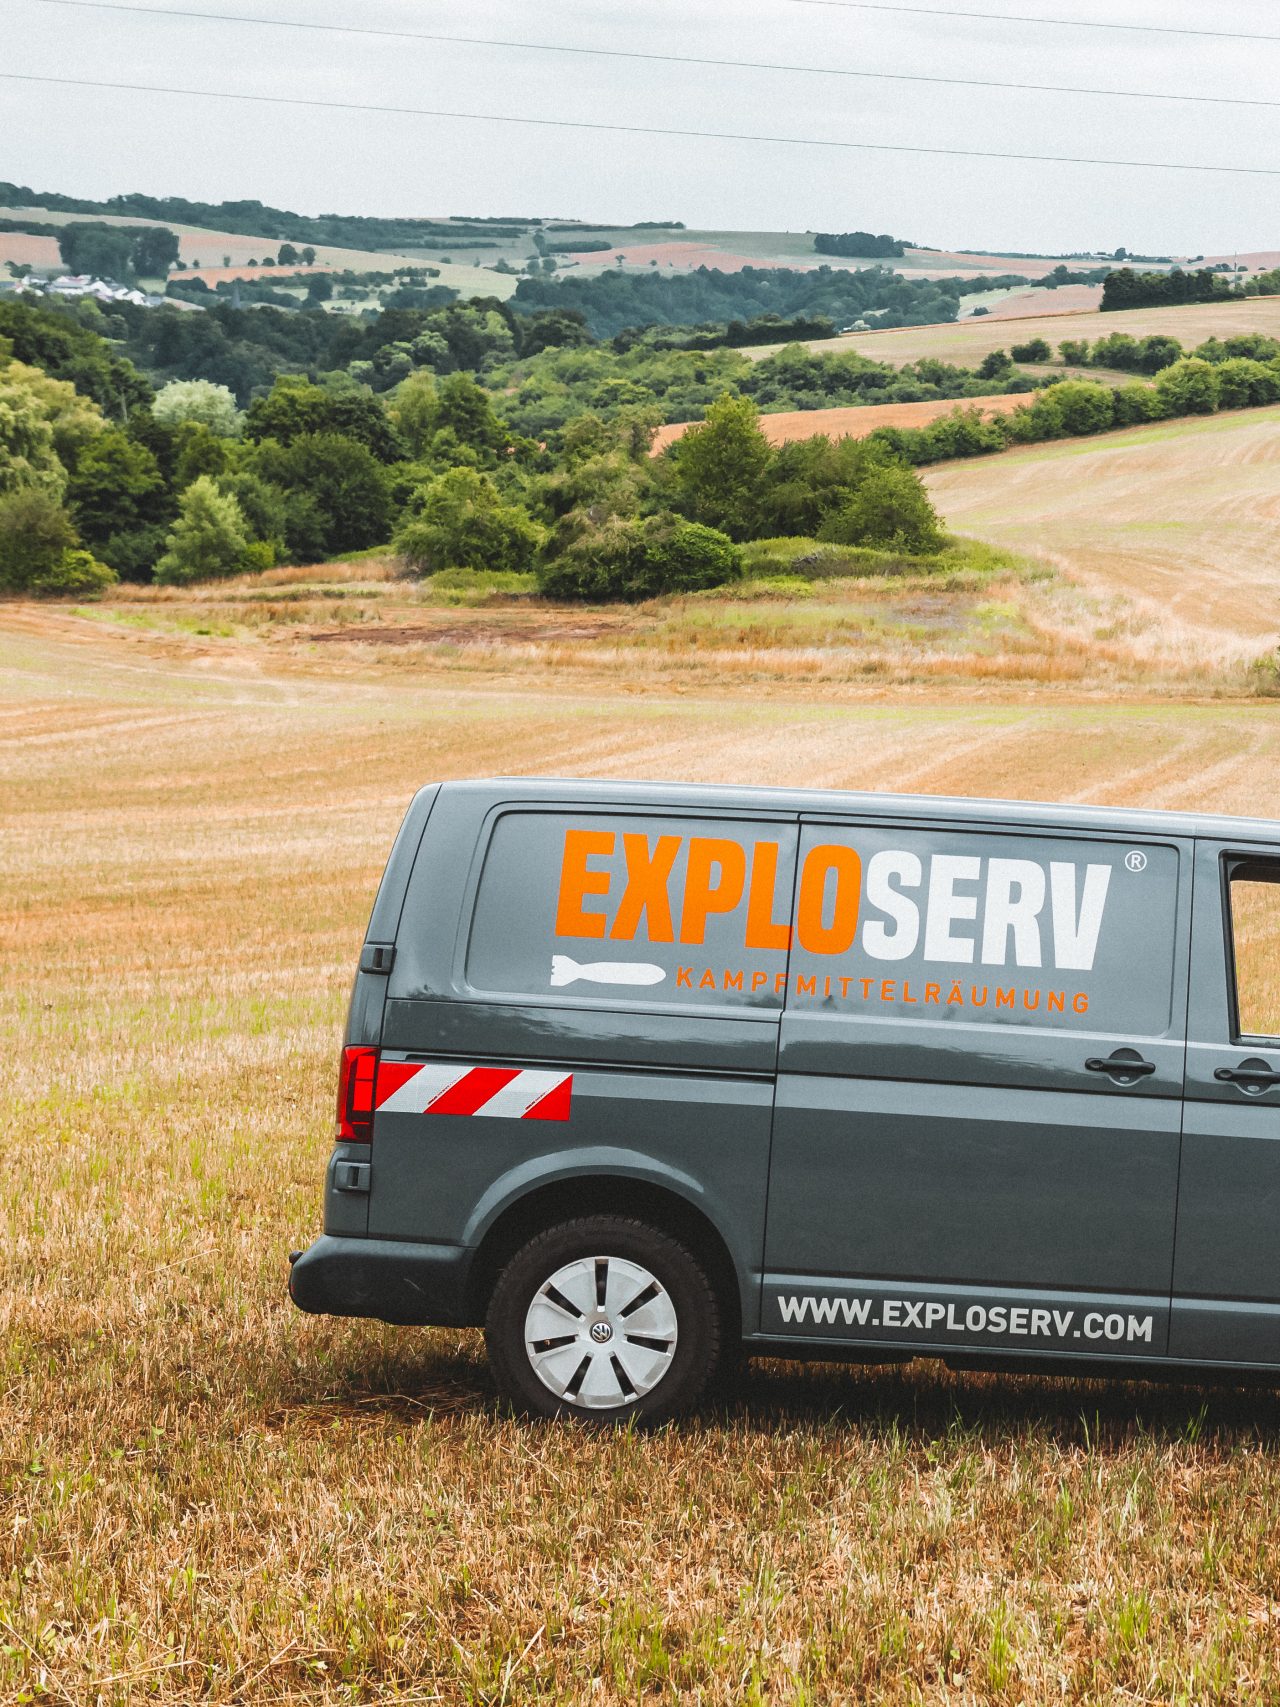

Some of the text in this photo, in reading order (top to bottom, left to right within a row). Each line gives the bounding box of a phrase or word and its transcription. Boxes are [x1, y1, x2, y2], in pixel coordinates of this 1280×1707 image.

[554, 828, 1113, 970] EXPLOSERV
[675, 965, 1090, 1014] KAMPFMITTELRÄUMUNG
[777, 1295, 1153, 1342] WWW.EXPLOSERV.COM
